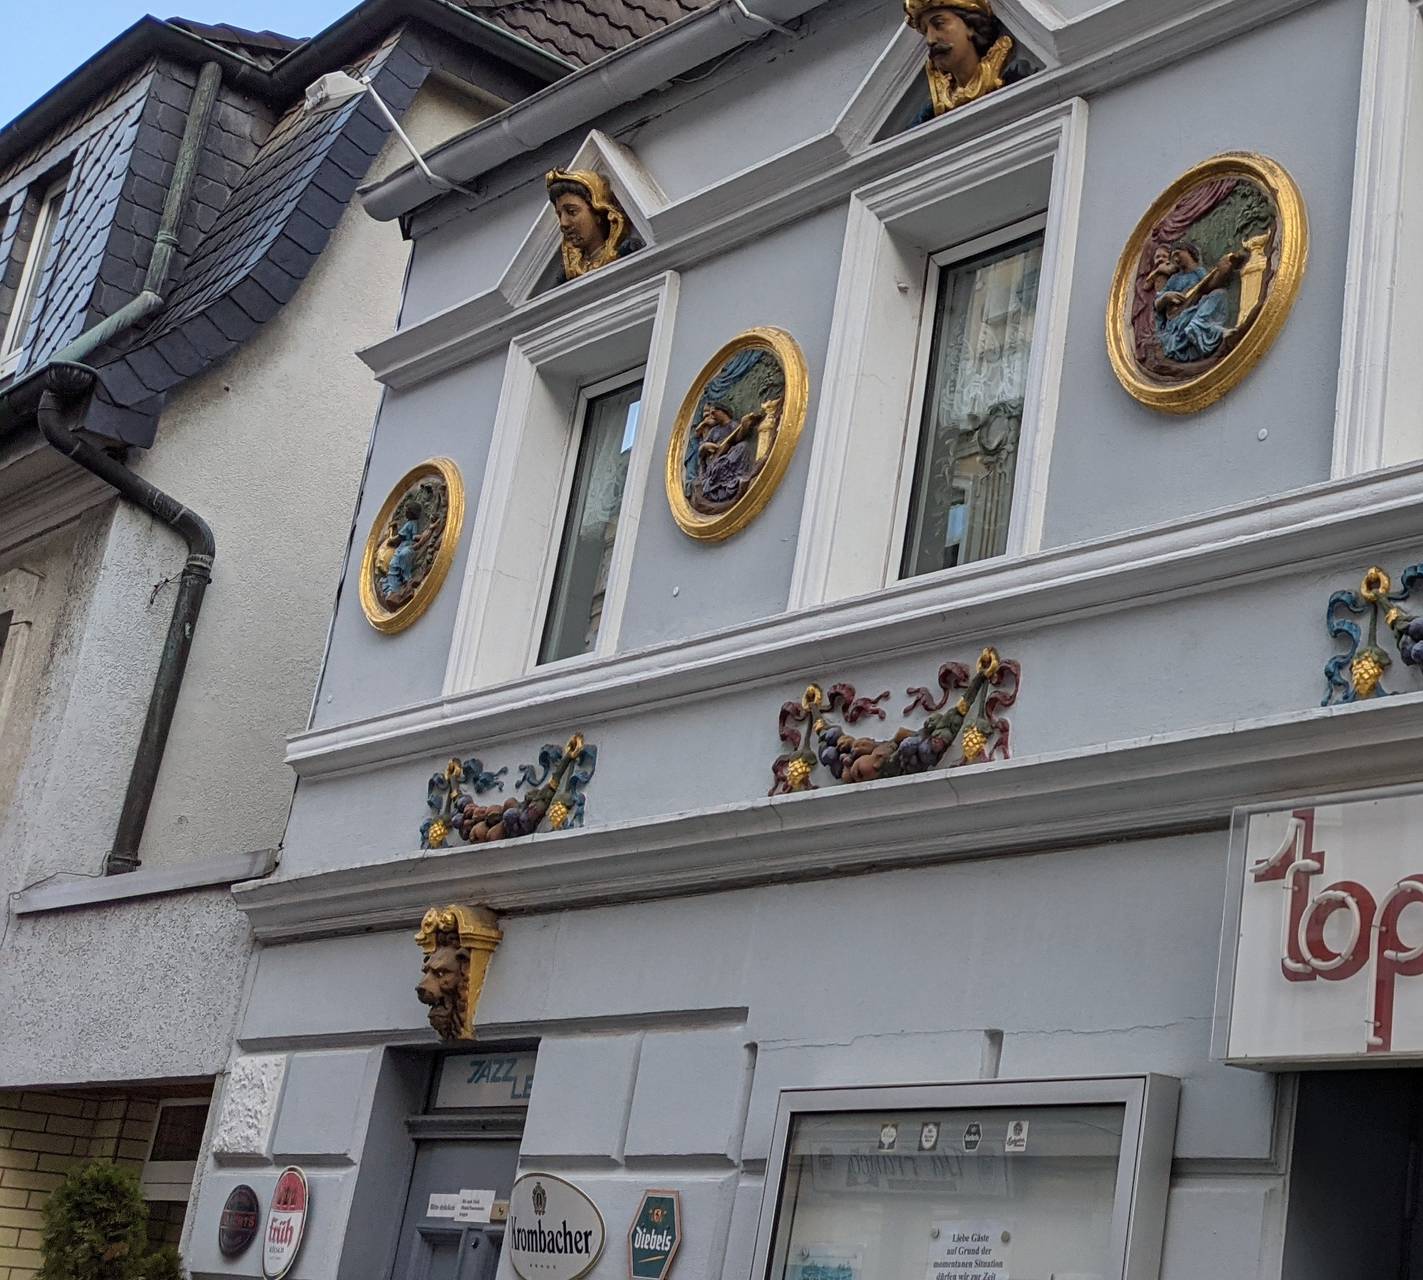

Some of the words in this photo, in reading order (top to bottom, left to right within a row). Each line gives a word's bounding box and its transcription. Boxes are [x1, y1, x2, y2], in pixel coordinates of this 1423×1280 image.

[467, 1058, 518, 1084] JAZZ
[511, 1216, 592, 1257] Krombacher
[952, 1233, 970, 1242] Liebe
[971, 1232, 990, 1242] Gäste
[946, 1246, 958, 1256] auf
[958, 1246, 980, 1256] Grund
[981, 1246, 992, 1256] der
[933, 1260, 973, 1268] momentanen
[974, 1259, 1003, 1268] Situation
